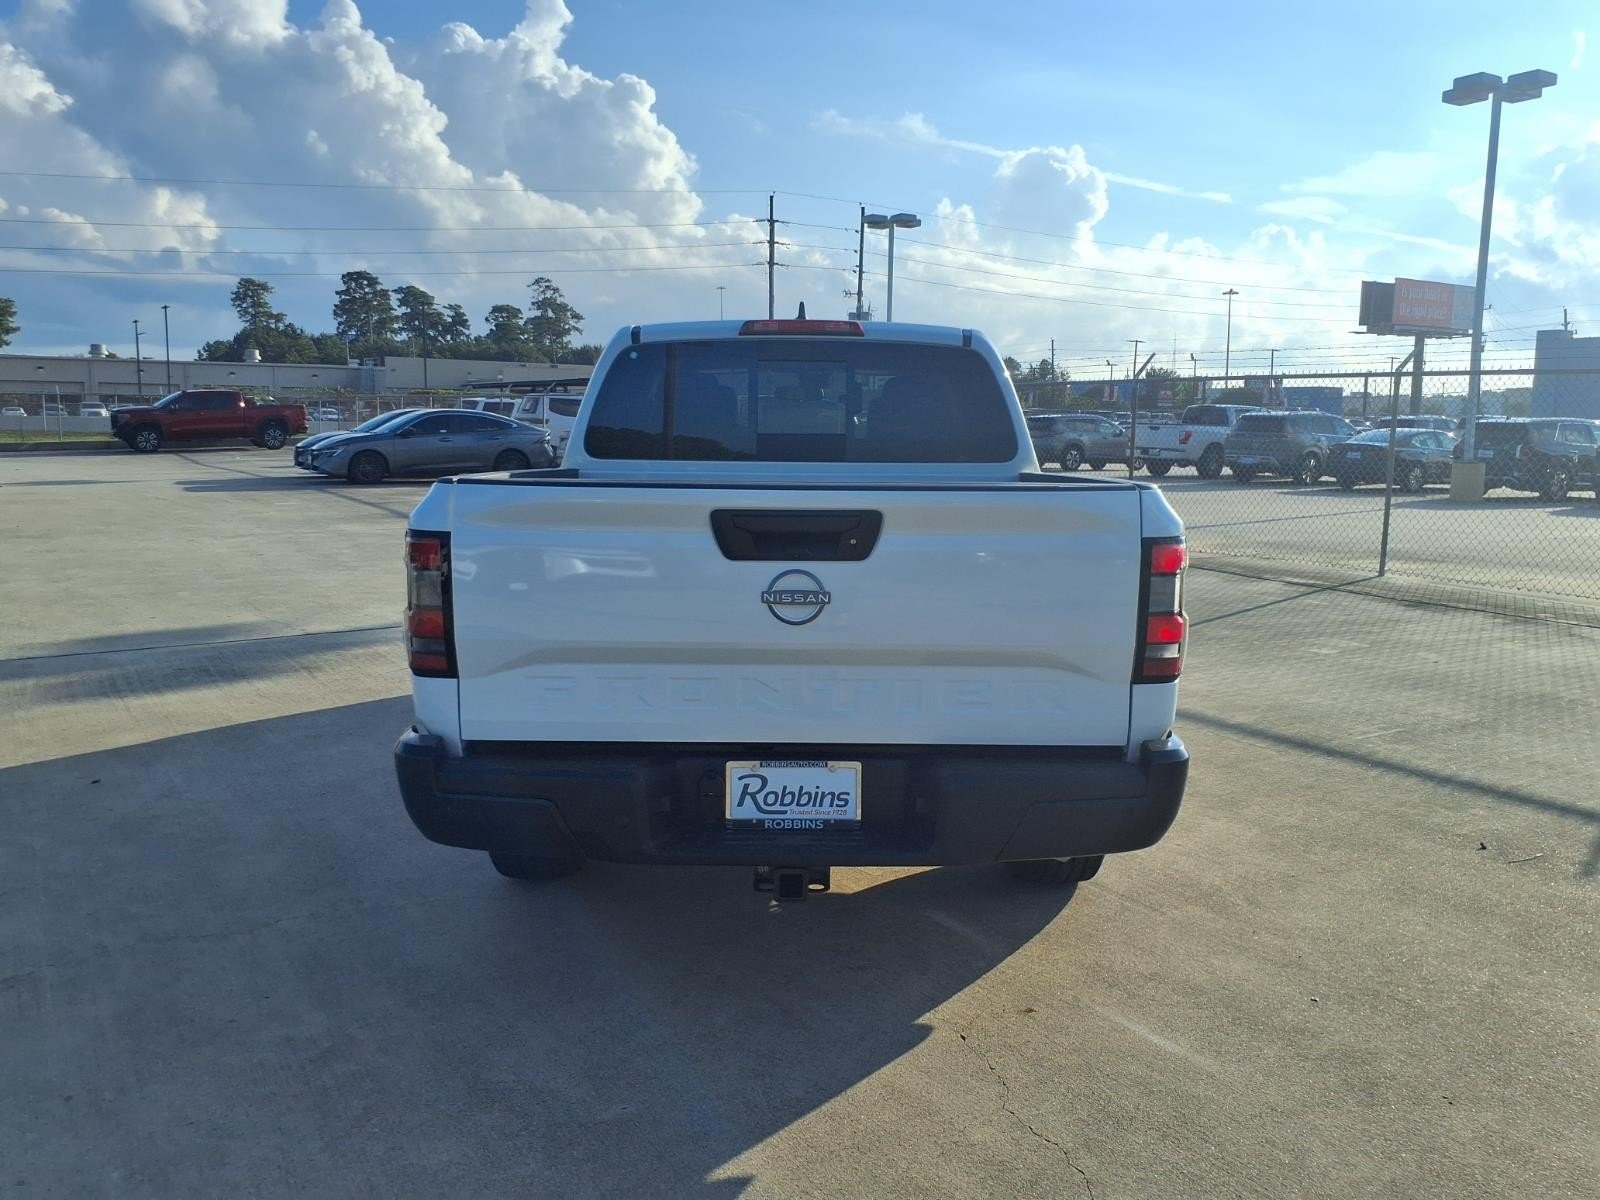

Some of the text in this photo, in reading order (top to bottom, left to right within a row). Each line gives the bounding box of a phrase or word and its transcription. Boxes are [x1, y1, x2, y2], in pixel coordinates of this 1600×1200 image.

[763, 593, 829, 603] NISSAN
[737, 773, 851, 815] Robbins
[765, 819, 824, 829] ROBBINS
